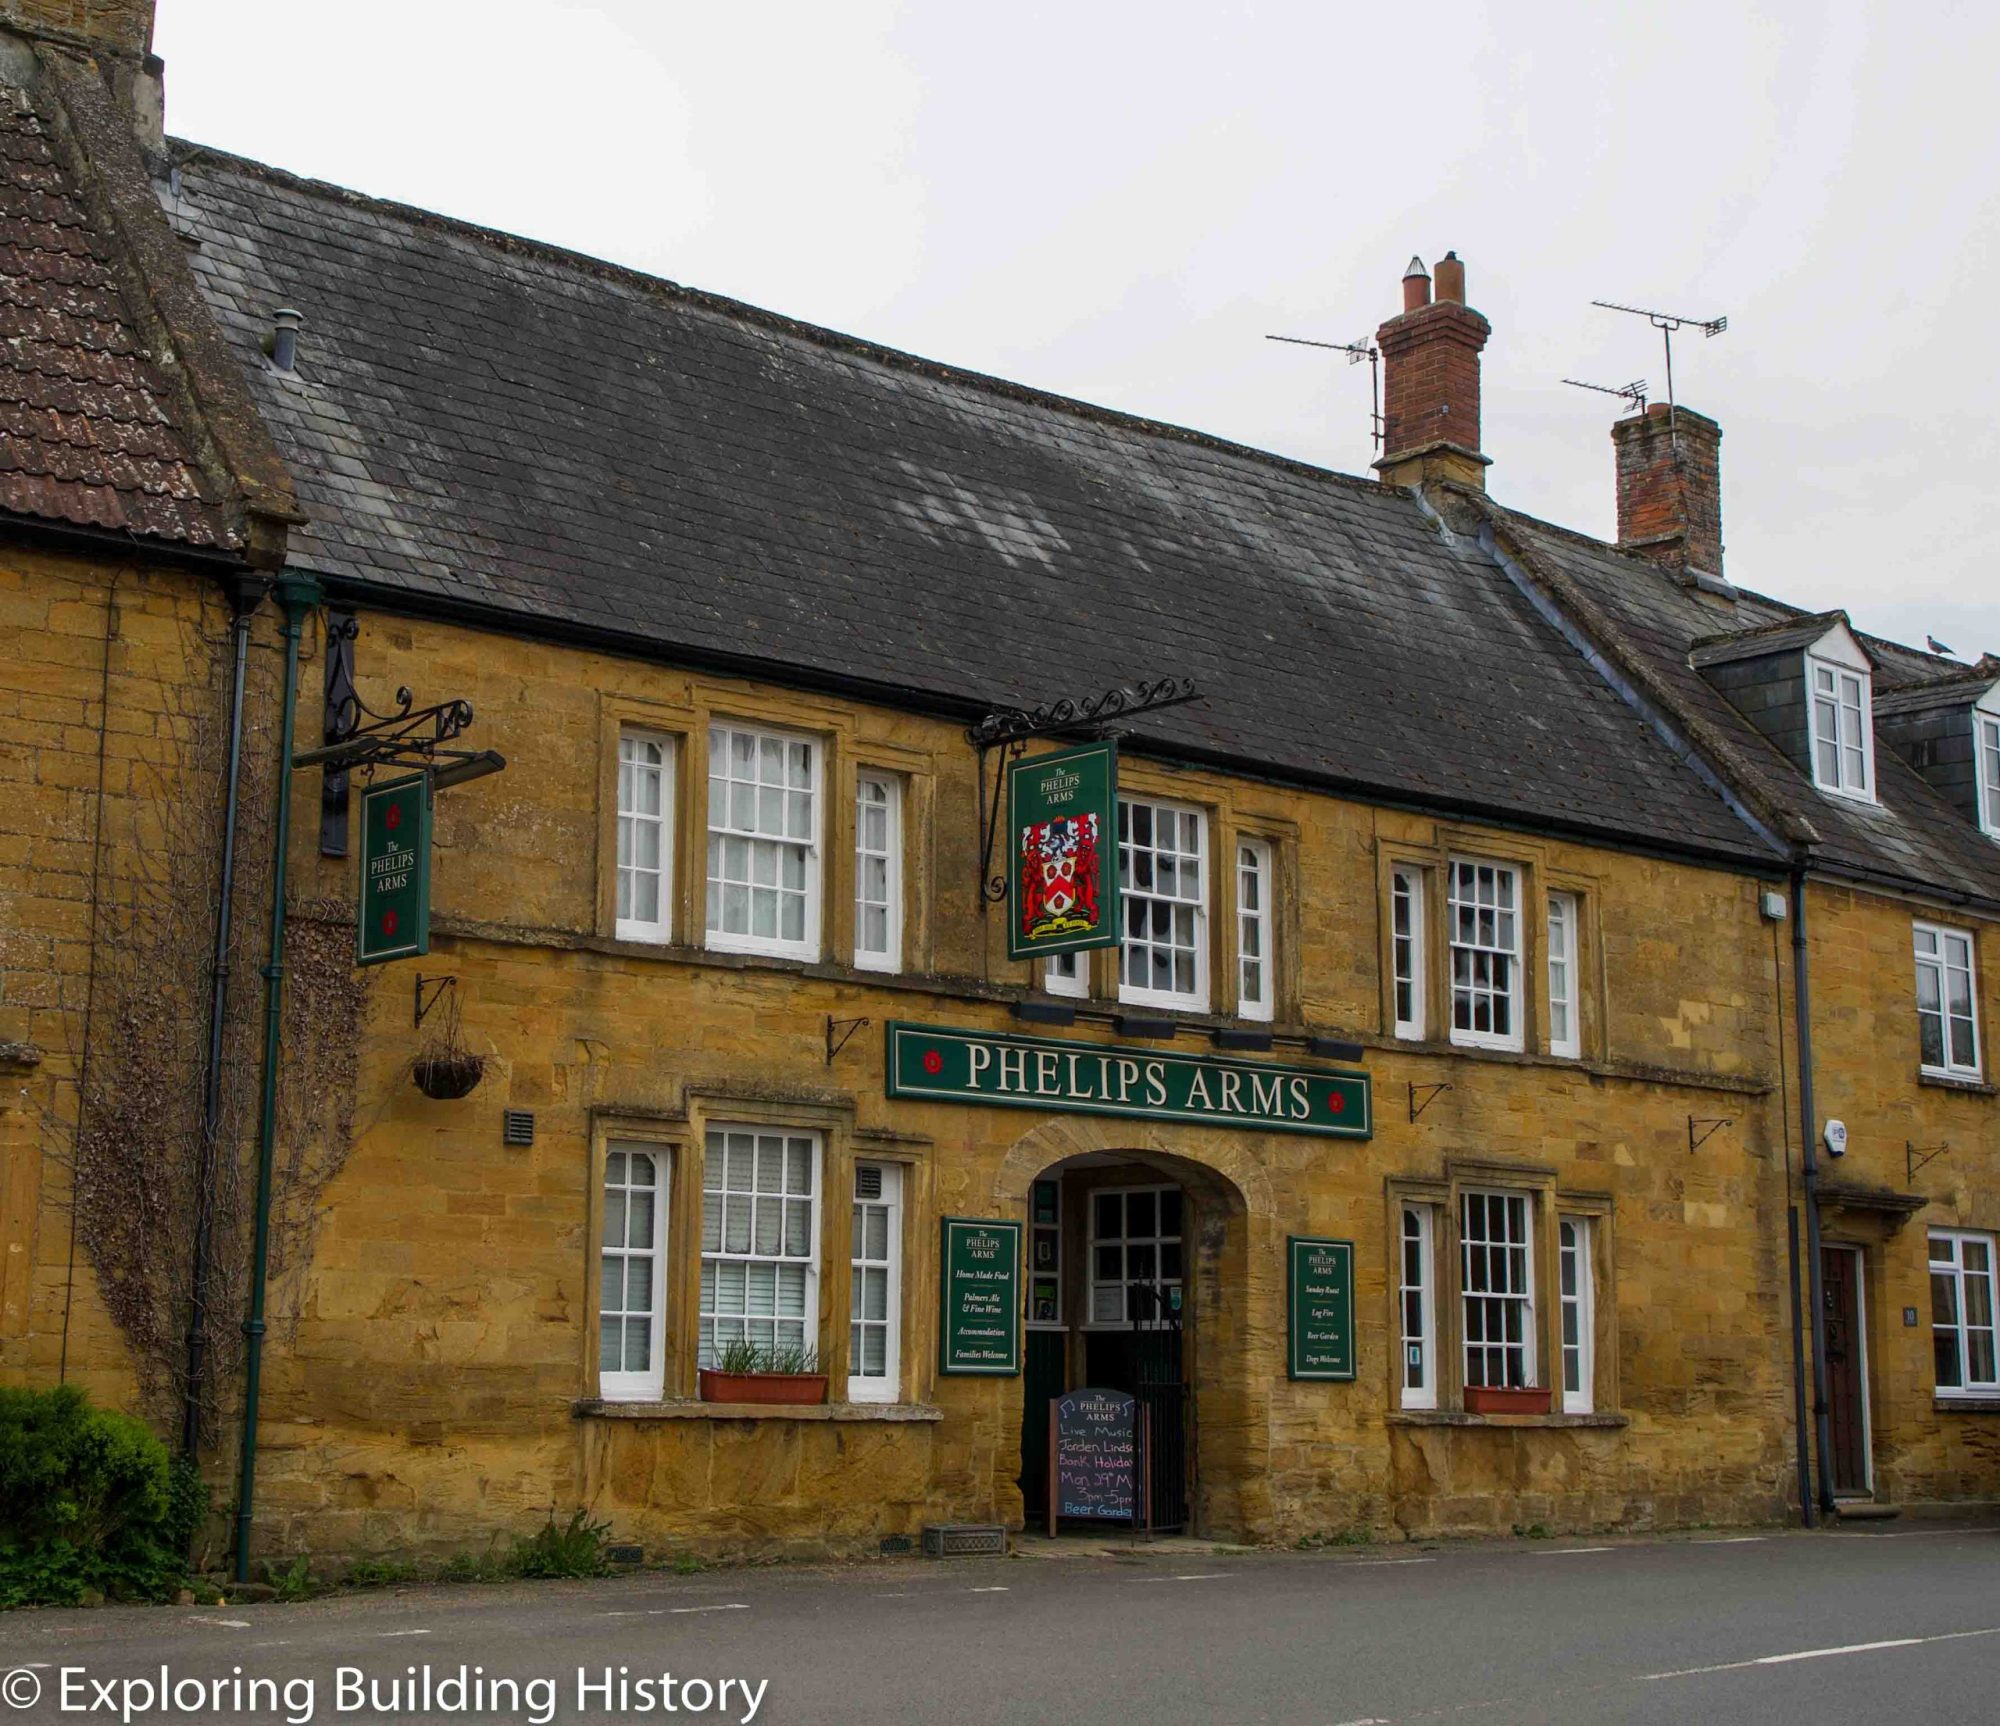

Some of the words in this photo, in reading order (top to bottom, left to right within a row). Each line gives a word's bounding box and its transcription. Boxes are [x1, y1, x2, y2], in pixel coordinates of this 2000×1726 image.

[1056, 768, 1066, 777] The
[1041, 776, 1080, 792] PHELIPS
[1046, 790, 1074, 805] ARMS
[387, 841, 399, 853] The
[371, 852, 414, 875] PHELIPS
[377, 873, 407, 893] ARMS
[965, 1043, 1166, 1105] PHELIPS
[1185, 1068, 1311, 1120] ARMS
[966, 1238, 1000, 1248] PHELIPS
[971, 1249, 995, 1259] ARMS
[1308, 1256, 1337, 1265] PHELIPS
[956, 1269, 975, 1279] Home
[975, 1270, 993, 1280] Made
[994, 1271, 1010, 1280] Food
[1313, 1266, 1333, 1276] ARMS
[1305, 1285, 1325, 1296] Sunday
[1325, 1286, 1340, 1294] Roast
[964, 1292, 988, 1302] Palmers
[989, 1293, 1000, 1302] Ale
[962, 1303, 969, 1312] &
[970, 1304, 985, 1313] Fine
[985, 1304, 1002, 1314] Wine
[1311, 1308, 1322, 1319] Log
[1322, 1308, 1334, 1317] Fire
[957, 1326, 1006, 1337] Accommodation
[1307, 1331, 1319, 1340] Beer
[1319, 1331, 1339, 1341] Garden
[955, 1349, 981, 1359] Families
[982, 1350, 1008, 1360] Welcome
[1080, 1402, 1121, 1412] PHELIPS
[1086, 1413, 1115, 1421] ARMS
[1060, 1423, 1087, 1436] Live
[1094, 1426, 1133, 1438] Music
[1059, 1453, 1090, 1468] Bank
[1065, 1501, 1094, 1515] Beer
